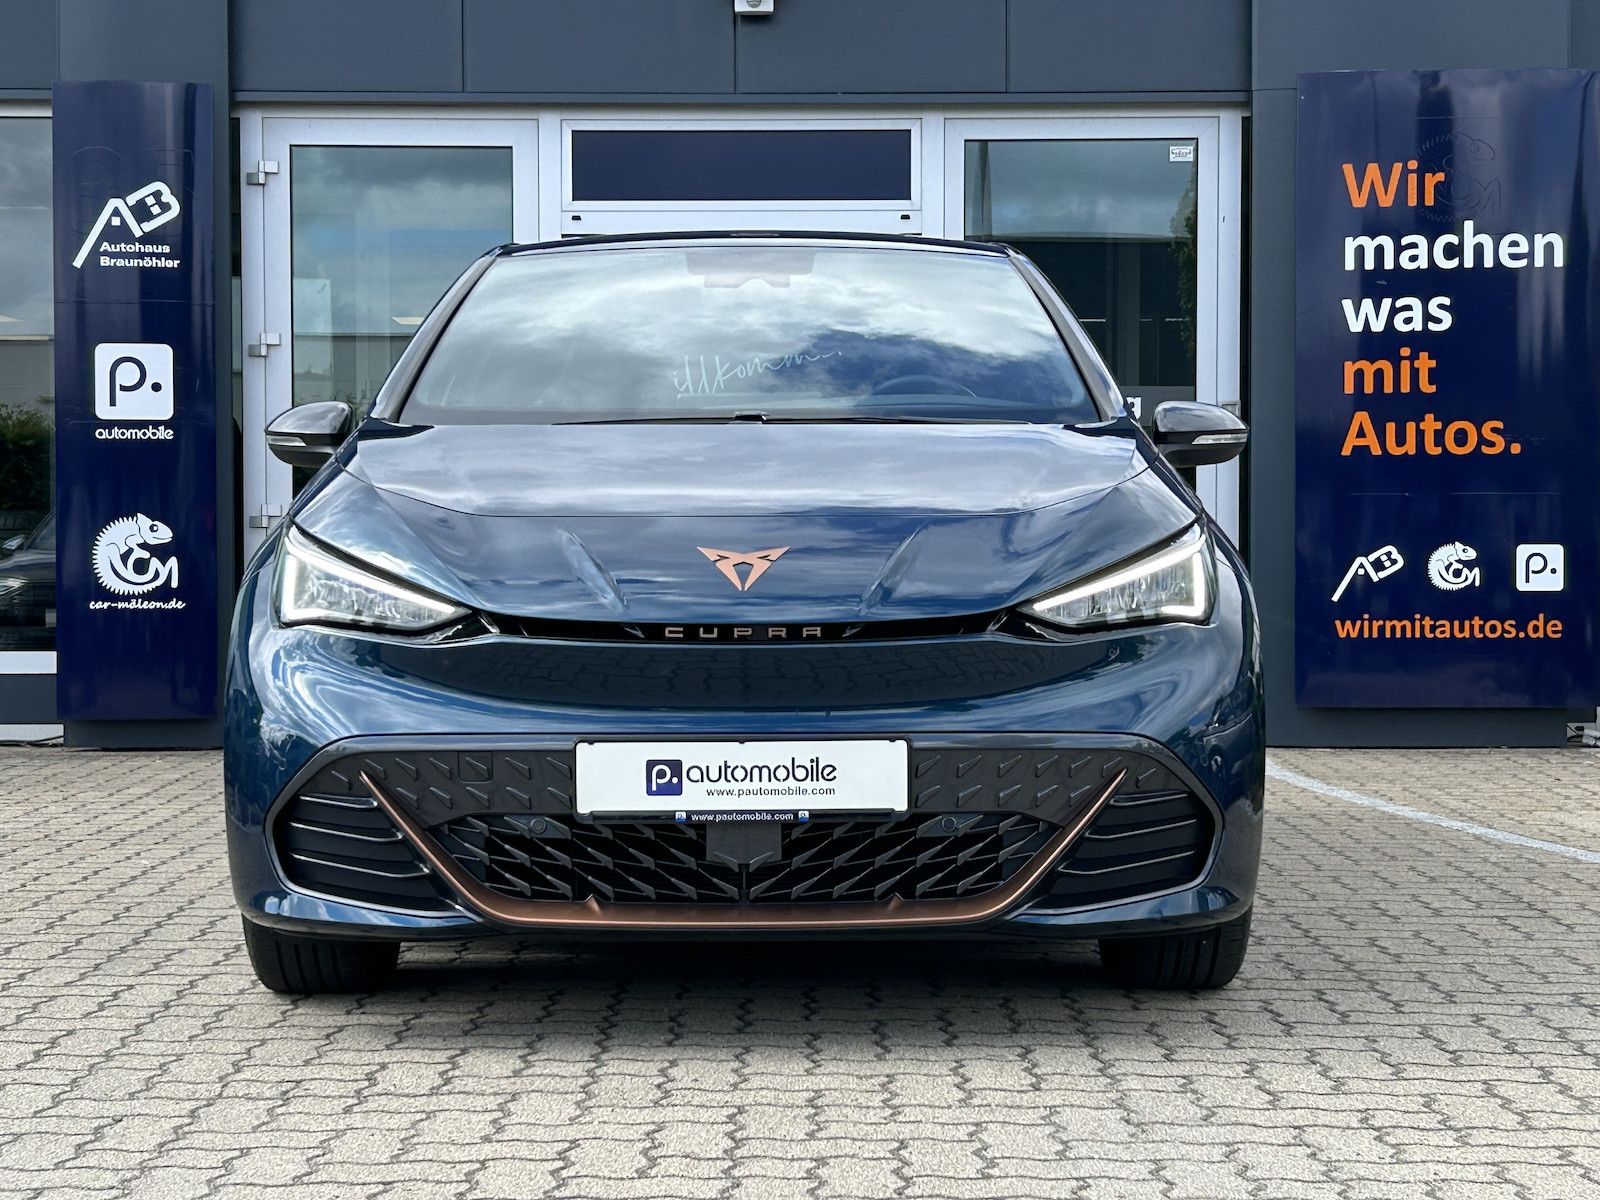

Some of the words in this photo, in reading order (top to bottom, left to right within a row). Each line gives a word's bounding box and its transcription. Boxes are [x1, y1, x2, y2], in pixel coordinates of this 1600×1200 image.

[1342, 160, 1445, 208] Wir
[99, 241, 171, 253] Autohaus
[1344, 219, 1564, 271] machen
[99, 256, 181, 268] Braunöhler
[1341, 295, 1453, 333] was
[1343, 347, 1437, 395] mit
[95, 425, 174, 440] automobile
[1340, 411, 1522, 456] Autos.
[89, 597, 186, 610] car-mäleon.de
[664, 626, 822, 639] CUPRA
[1334, 613, 1563, 639] wirmitautos.de
[686, 757, 838, 783] automobile
[706, 786, 836, 798] www.pautomobile.com
[691, 811, 794, 823] www.pautomobile.com
